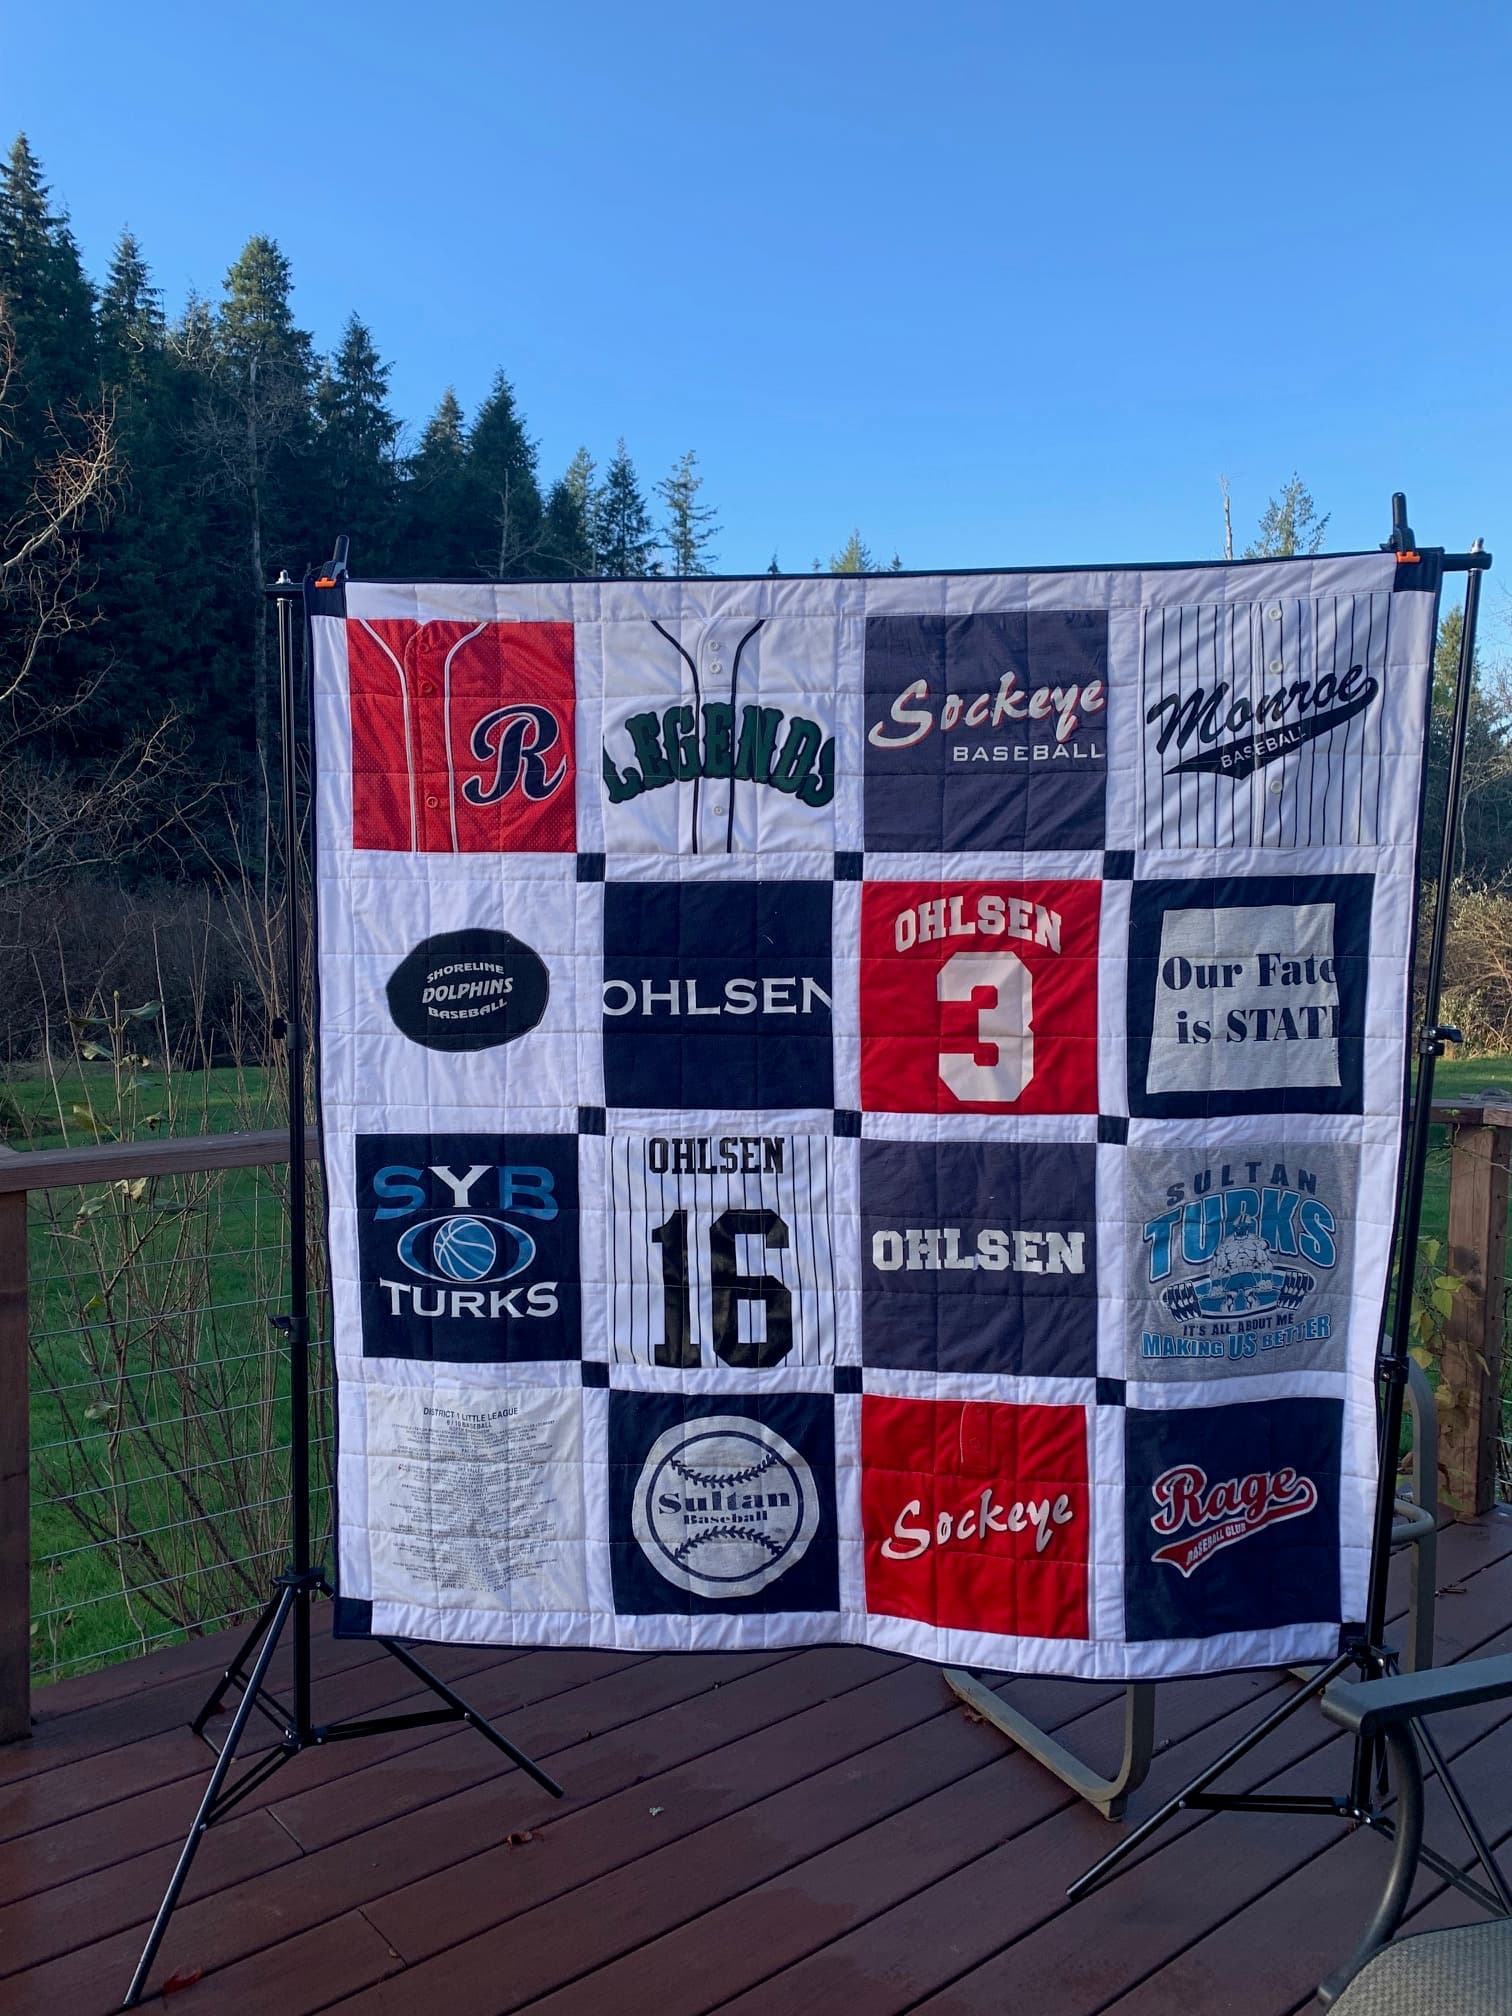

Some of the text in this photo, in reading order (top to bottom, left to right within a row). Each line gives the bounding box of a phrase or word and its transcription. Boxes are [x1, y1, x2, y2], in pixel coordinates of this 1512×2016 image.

[868, 670, 1105, 748] Sockeye
[1146, 664, 1379, 754] Monroe
[461, 703, 567, 807] R
[953, 743, 1106, 762] BASEBALL
[1220, 727, 1307, 769] BASEBALL
[895, 895, 1062, 954] OHLSEN
[421, 977, 514, 1004] DOLPHINS
[426, 962, 505, 984] SHORELINE
[1162, 956, 1243, 990] Our
[427, 998, 508, 1019] BASEBALL
[602, 976, 833, 1016] OHLSEN
[936, 951, 1034, 1103] 3
[1176, 1010, 1212, 1045] is
[648, 1136, 786, 1175] OHLSEN
[372, 1164, 560, 1221] SYB
[1166, 1161, 1317, 1207] SULTAN
[871, 1227, 1087, 1275] OHLSEN
[1143, 1187, 1337, 1284] TURKS
[379, 1278, 559, 1319] TURKS
[651, 1208, 794, 1369] 16
[1142, 1313, 1332, 1360] MAKING US BETTER
[1183, 1313, 1294, 1337] IT'S ALL ABOUT ME
[423, 1407, 455, 1419] DISTRICT
[461, 1413, 486, 1423] LITTLE
[487, 1407, 519, 1421] LEAGUE
[658, 1491, 792, 1515] Sultan
[684, 1510, 768, 1525] Baseball
[1151, 1464, 1297, 1535] Rage
[880, 1488, 1074, 1561] Sockeye
[1186, 1522, 1247, 1566] BASEBALL CLUB
